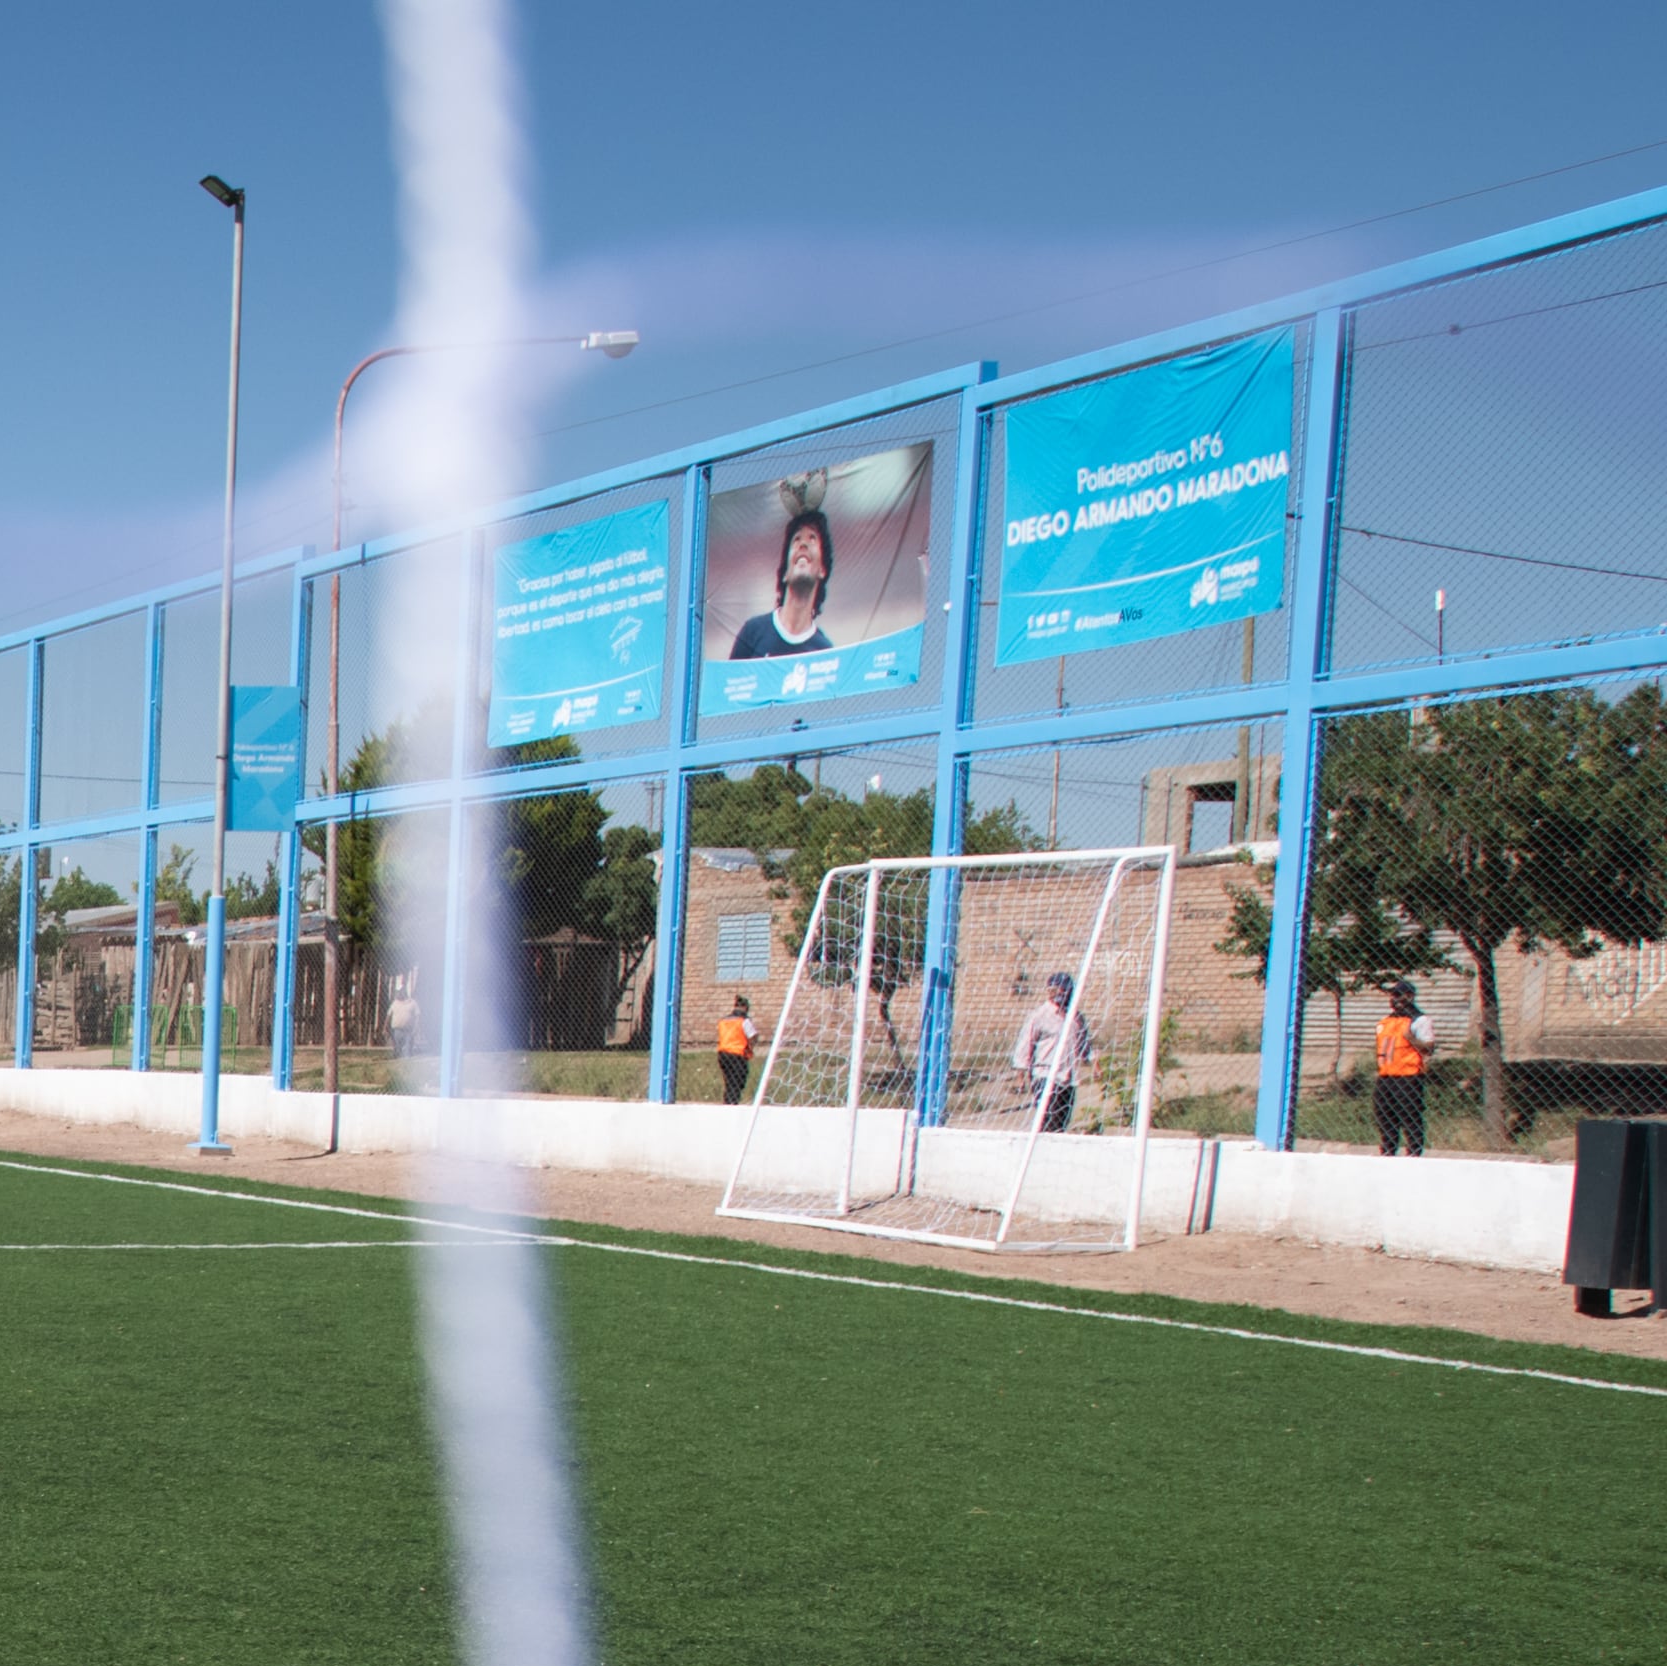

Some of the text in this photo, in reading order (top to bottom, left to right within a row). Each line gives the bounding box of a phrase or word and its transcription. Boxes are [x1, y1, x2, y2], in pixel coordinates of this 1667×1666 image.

[1077, 448, 1187, 494] Polideportivo
[1007, 450, 1289, 547] DIEGO ARMANDO MARADONA
[551, 573, 564, 589] por
[497, 602, 527, 621] porque
[548, 590, 577, 607] deporte
[578, 587, 592, 602] que
[542, 615, 564, 630] como
